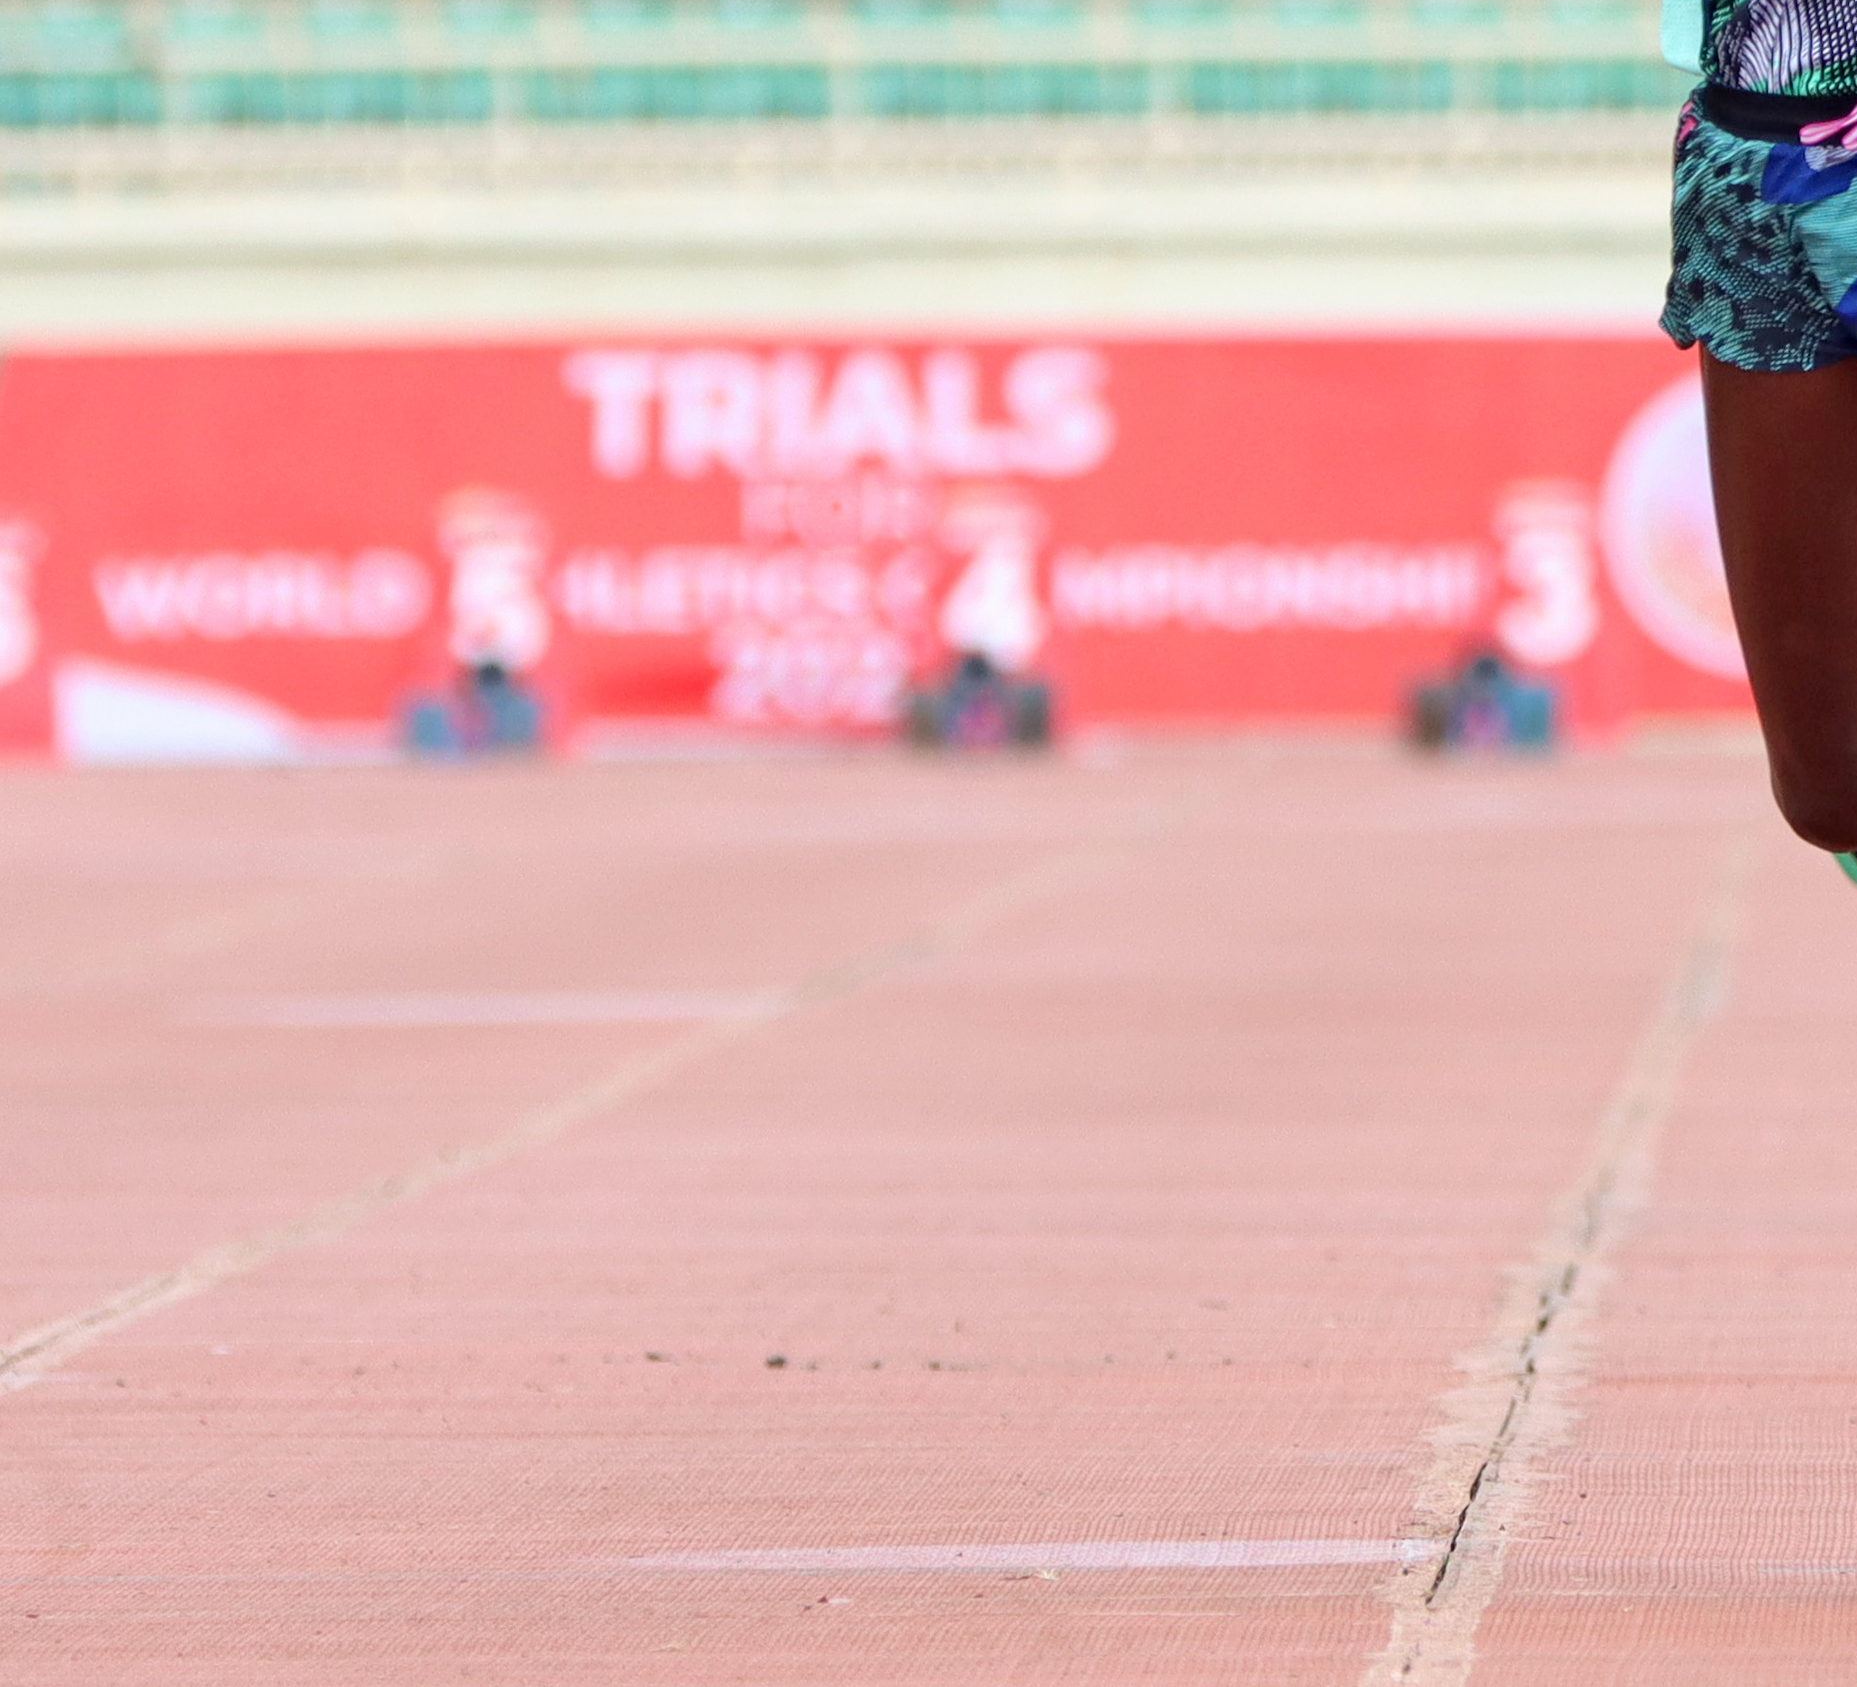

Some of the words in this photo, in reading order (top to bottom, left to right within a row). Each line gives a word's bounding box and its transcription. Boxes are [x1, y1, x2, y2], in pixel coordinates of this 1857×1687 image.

[562, 347, 1112, 478] TRIALS
[93, 548, 432, 642] WORLD
[938, 534, 1048, 672] 4
[1498, 527, 1598, 664] 3
